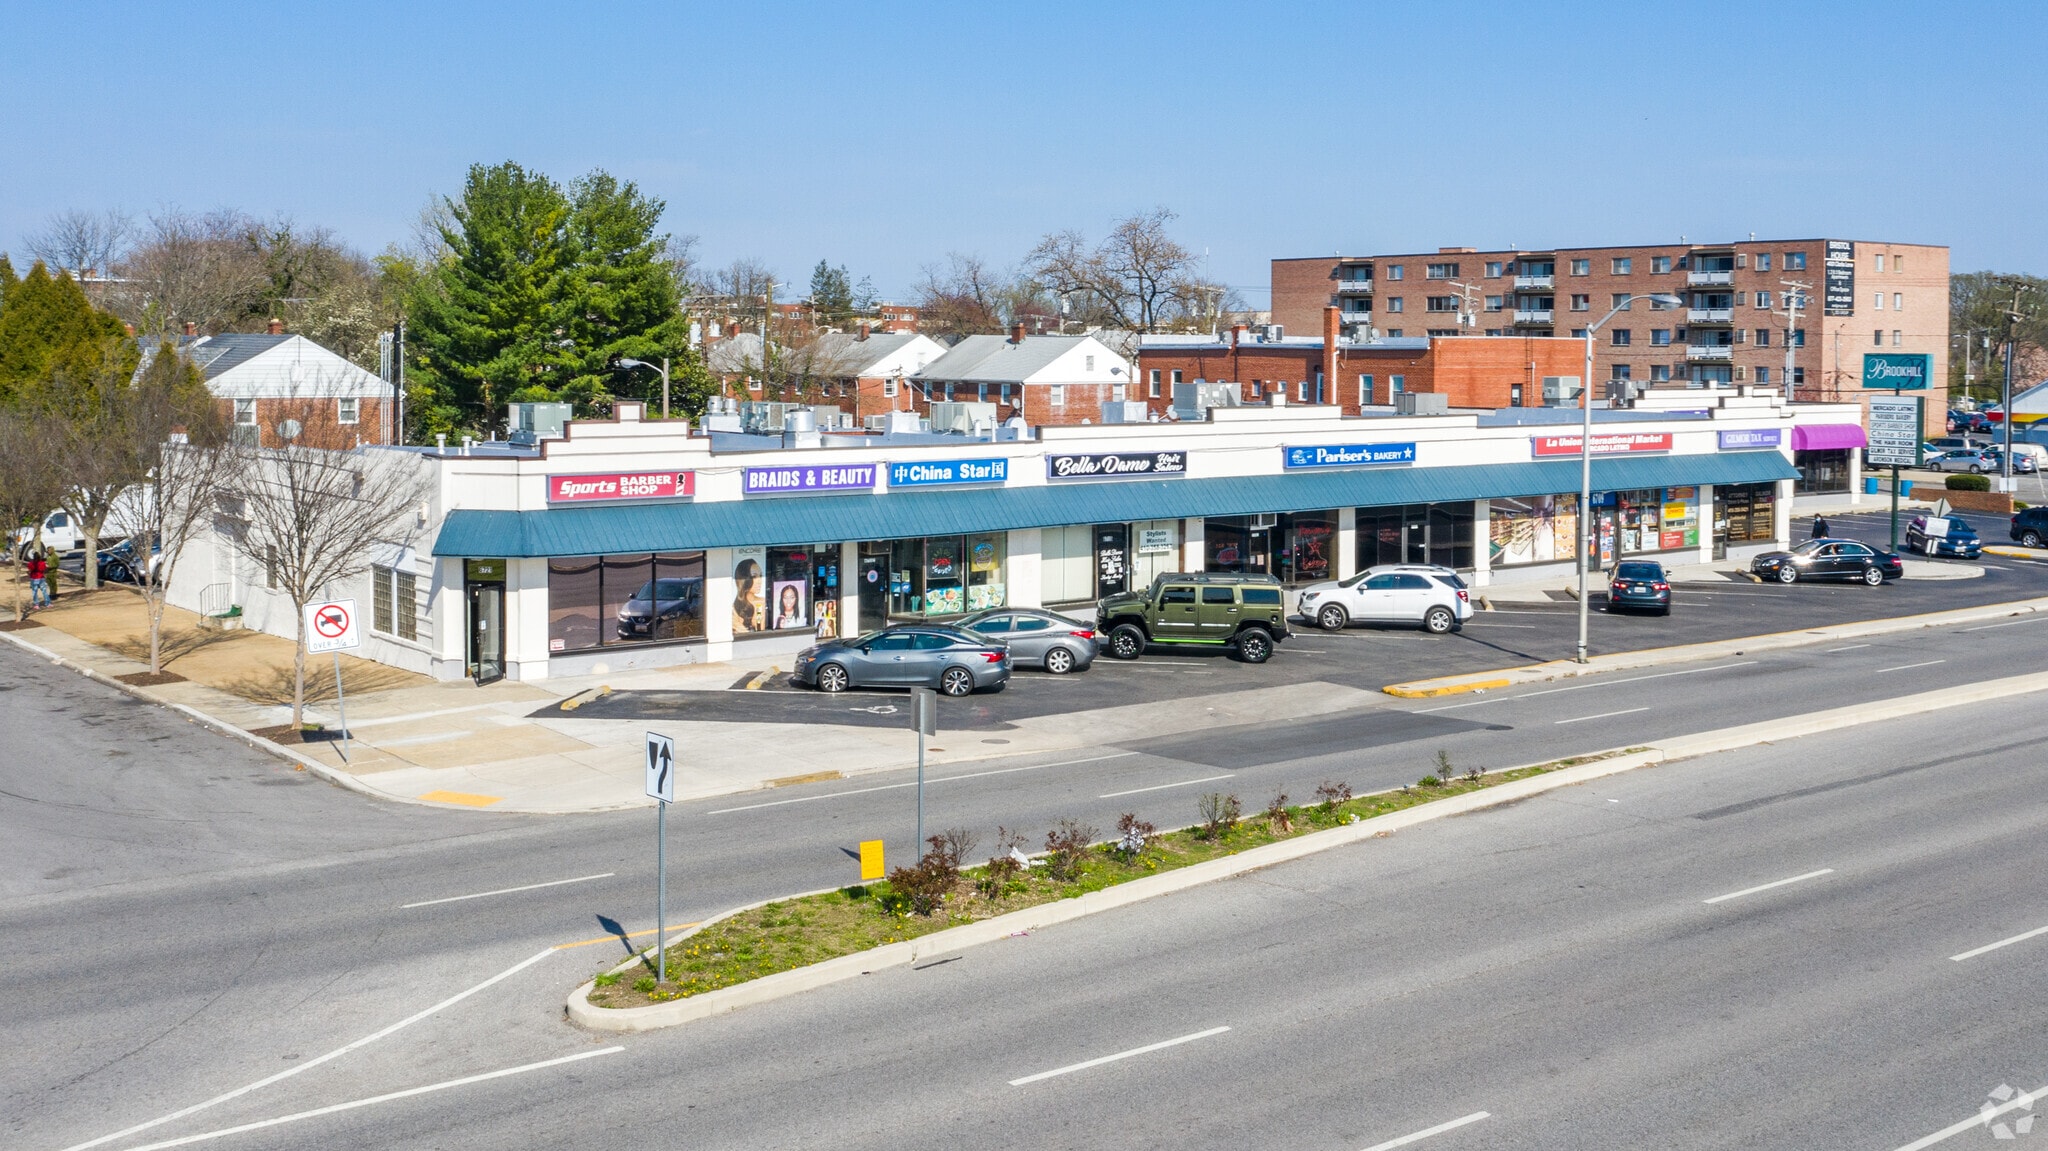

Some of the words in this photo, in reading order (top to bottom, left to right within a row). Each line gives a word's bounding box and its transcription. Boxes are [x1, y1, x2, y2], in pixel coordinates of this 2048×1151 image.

[1867, 358, 1922, 379] BROOKHILL
[1546, 438, 1558, 447] La
[1635, 434, 1662, 442] Market
[1157, 453, 1180, 464] Hair
[1316, 447, 1371, 463] Pariser's
[1373, 451, 1401, 460] BAKERY
[910, 465, 952, 481] China
[960, 462, 991, 479] Star
[1055, 456, 1100, 477] Bella
[1101, 455, 1150, 474] Dame
[1152, 462, 1183, 473] Salon
[620, 475, 672, 486] BARBER
[749, 472, 800, 488] BRAIDS
[805, 470, 818, 486] &
[822, 467, 873, 485] BEAUTY
[559, 480, 617, 497] Sports
[620, 485, 659, 496] SHOP
[1146, 530, 1167, 538] Stylists
